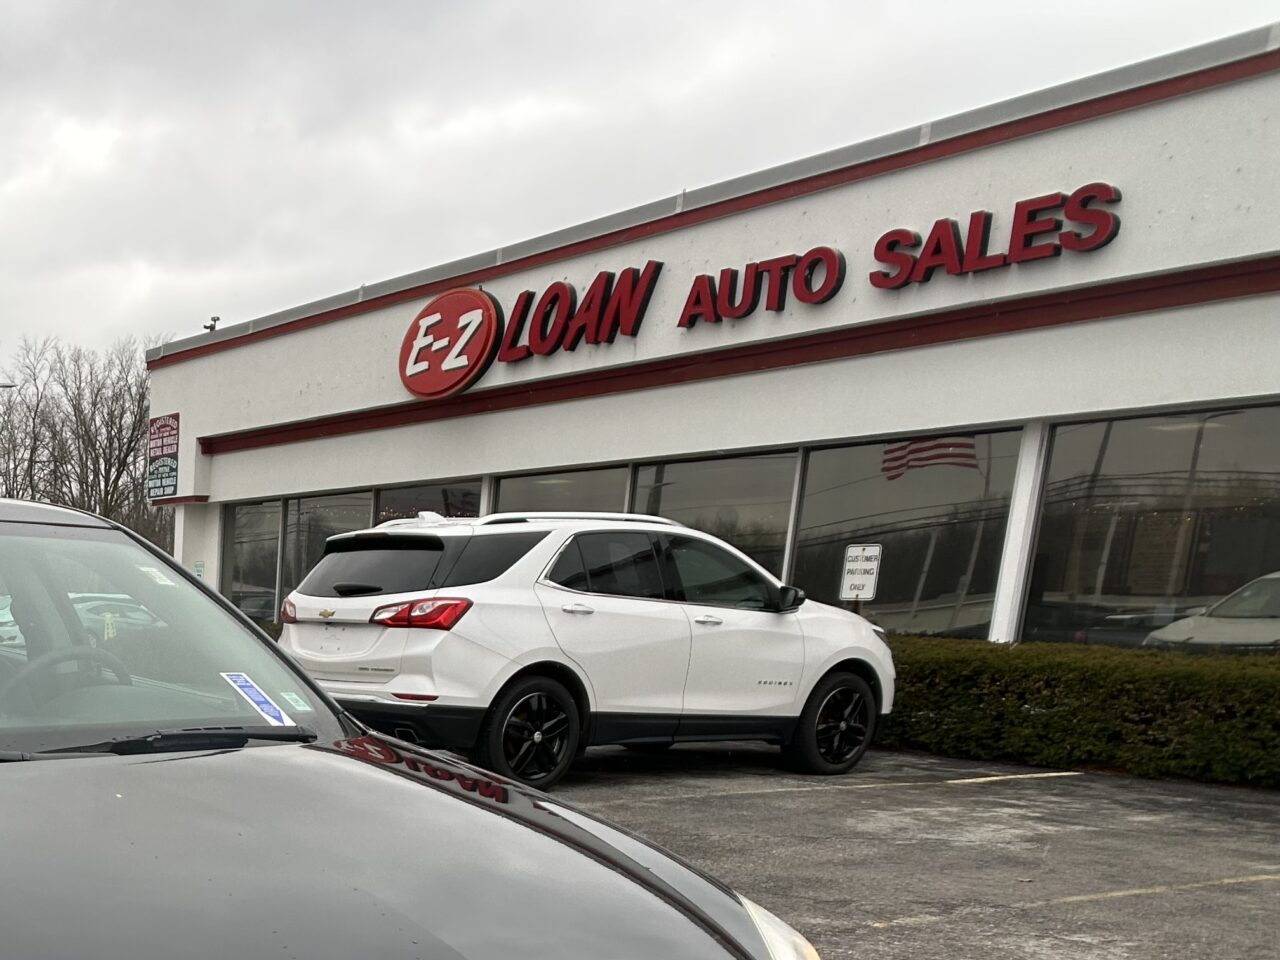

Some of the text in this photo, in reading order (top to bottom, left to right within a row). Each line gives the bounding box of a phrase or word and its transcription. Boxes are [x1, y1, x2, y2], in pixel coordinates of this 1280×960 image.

[404, 182, 1122, 377] E-Z LOAN AUTO SALES
[850, 583, 866, 591] ONLY
